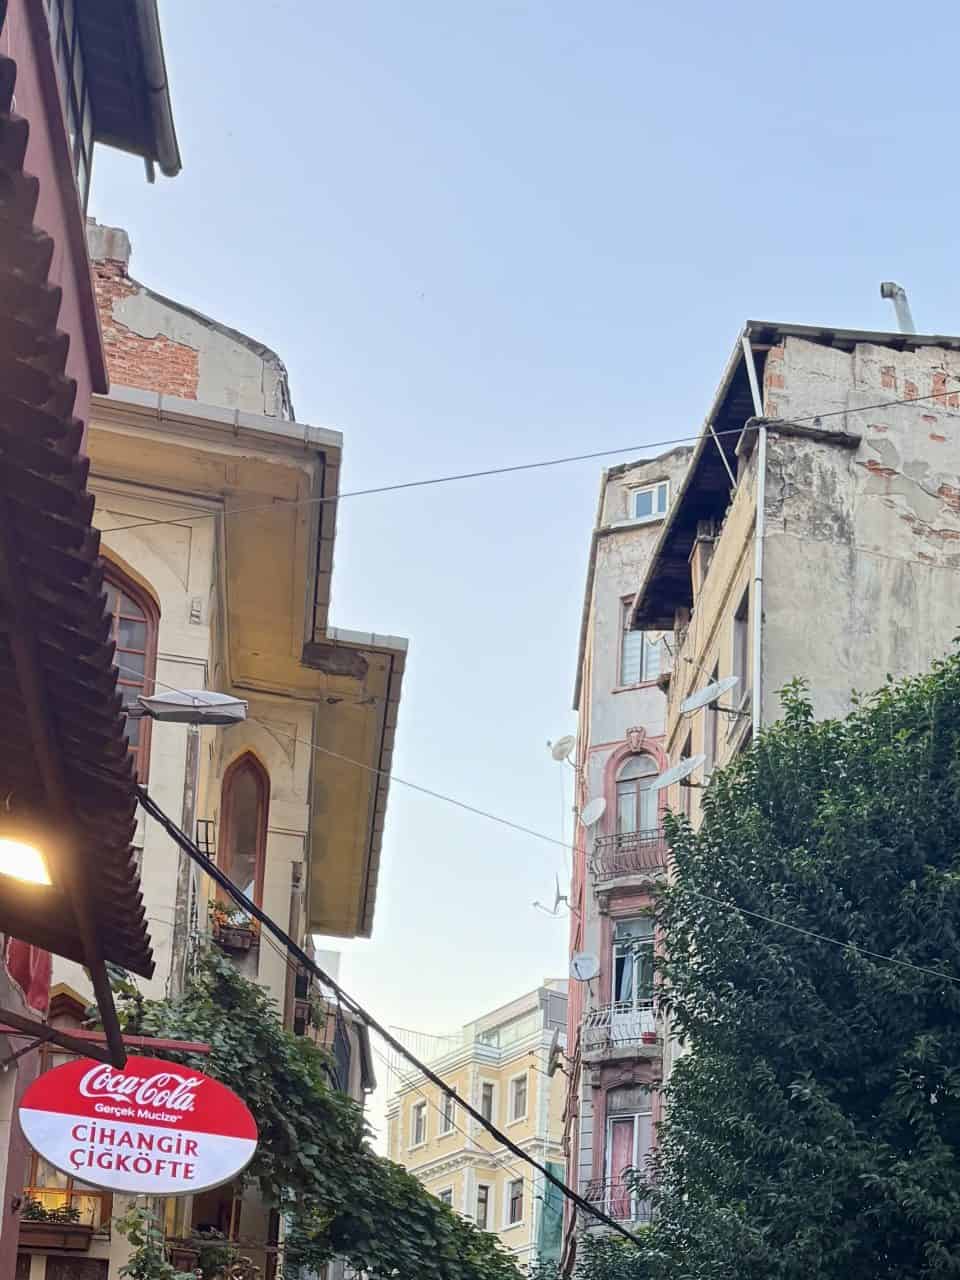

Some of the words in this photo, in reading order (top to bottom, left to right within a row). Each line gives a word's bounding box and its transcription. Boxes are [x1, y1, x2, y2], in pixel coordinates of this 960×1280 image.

[80, 1064, 204, 1111] Coca-Cola
[95, 1103, 136, 1117] Gerçek
[71, 1121, 199, 1157] CİHANGİR
[69, 1145, 196, 1180] ÇİĞKÖFTE
